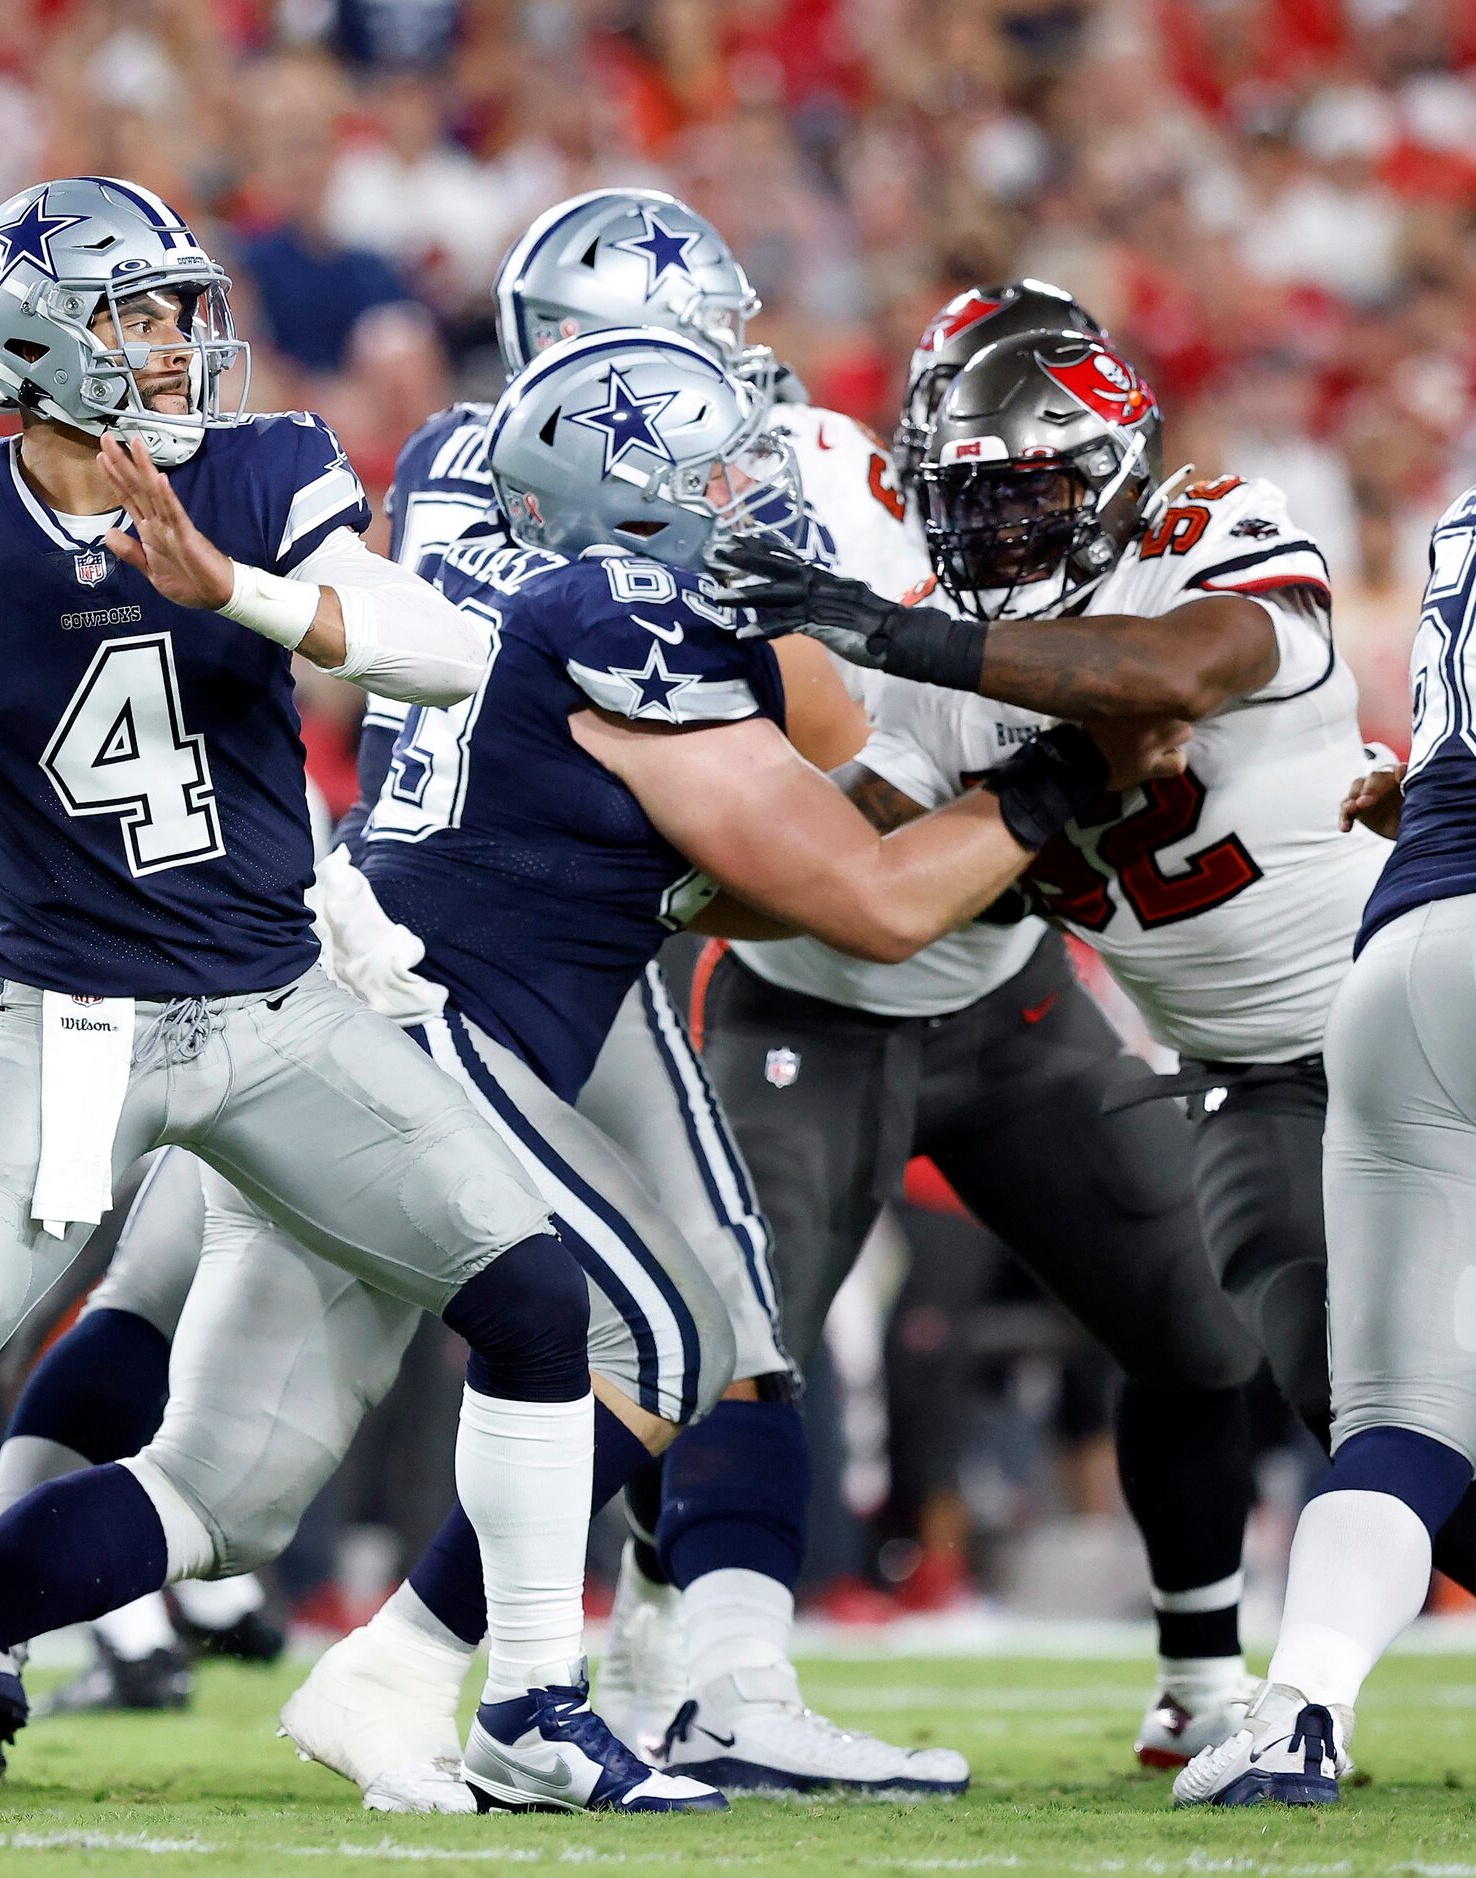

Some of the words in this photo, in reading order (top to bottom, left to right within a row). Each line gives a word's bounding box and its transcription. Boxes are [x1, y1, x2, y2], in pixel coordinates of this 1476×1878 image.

[80, 565, 102, 580] NFL
[60, 604, 142, 631] COWBOYS
[37, 630, 228, 880] 4
[60, 1016, 112, 1032] Wilson
